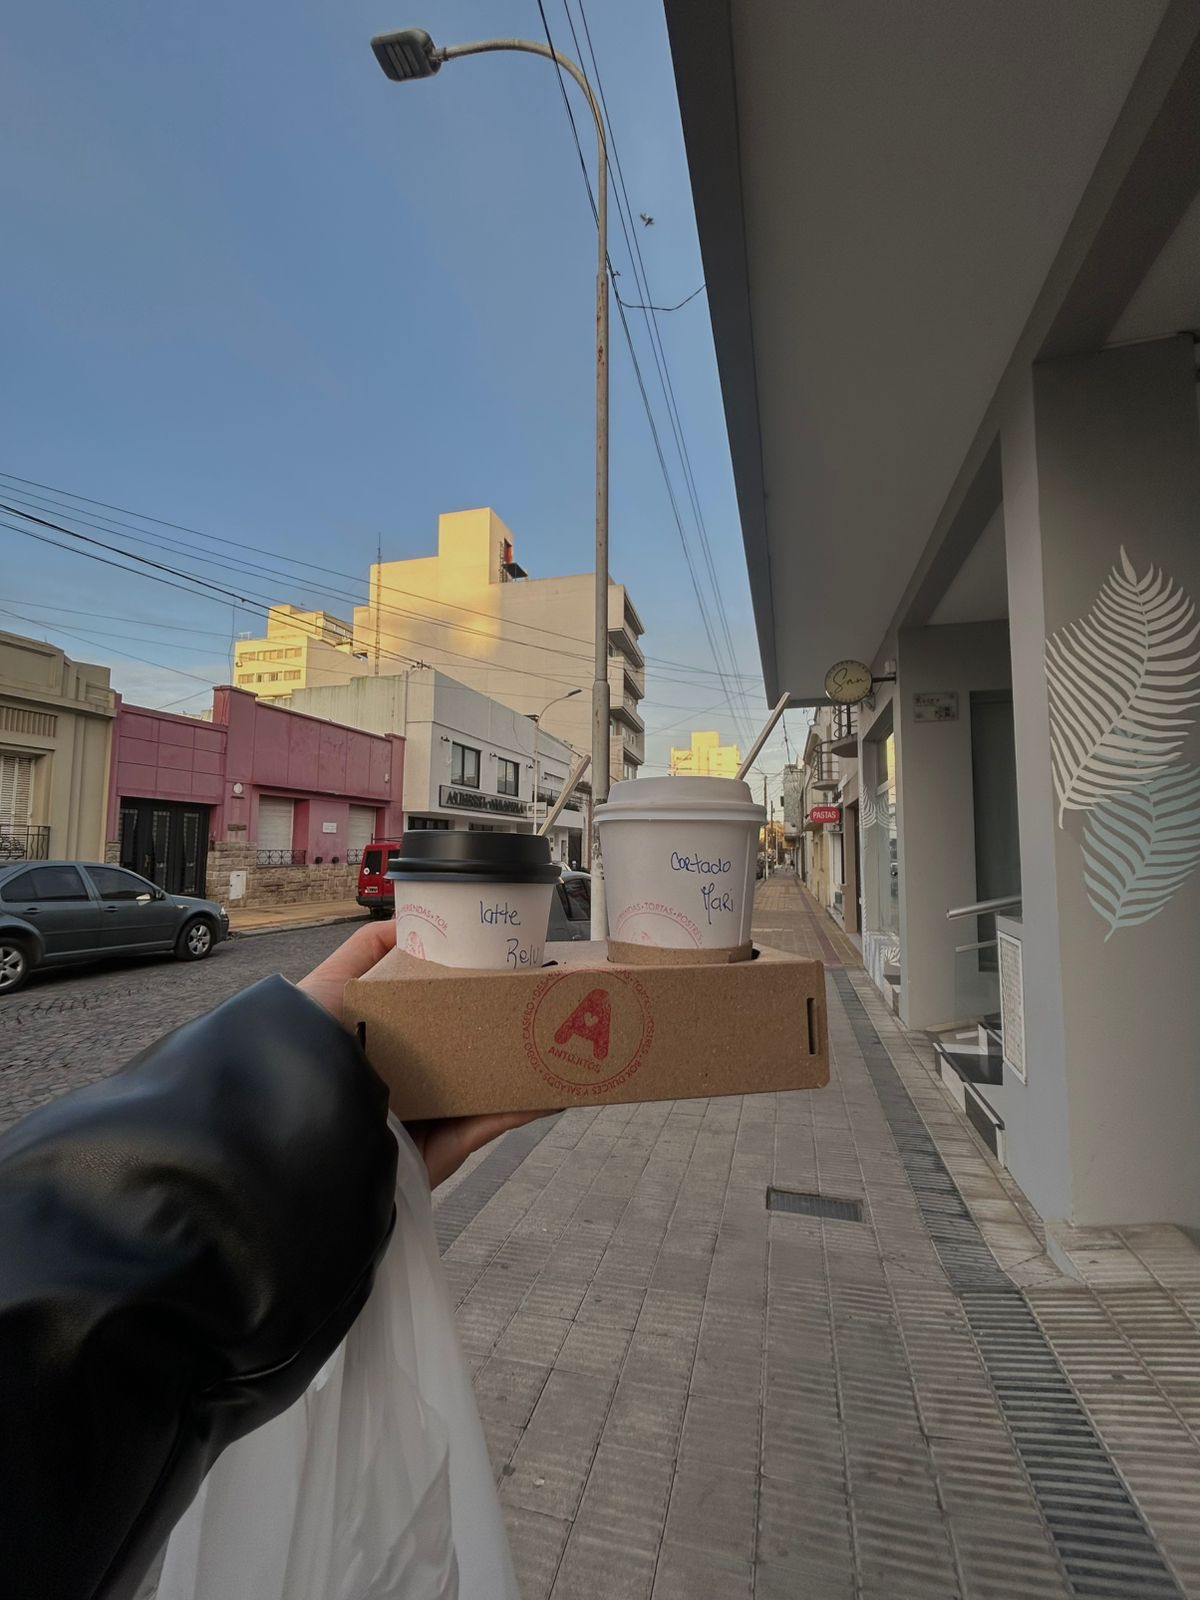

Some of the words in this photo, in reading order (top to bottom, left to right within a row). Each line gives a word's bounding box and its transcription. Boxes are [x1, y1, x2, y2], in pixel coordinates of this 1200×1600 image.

[812, 810, 837, 819] PASTAS
[644, 902, 673, 915] TORTAS
[522, 1002, 535, 1040] CASERO
[592, 1076, 626, 1095] DULCES
[548, 1046, 601, 1074] ANTOJITOS
